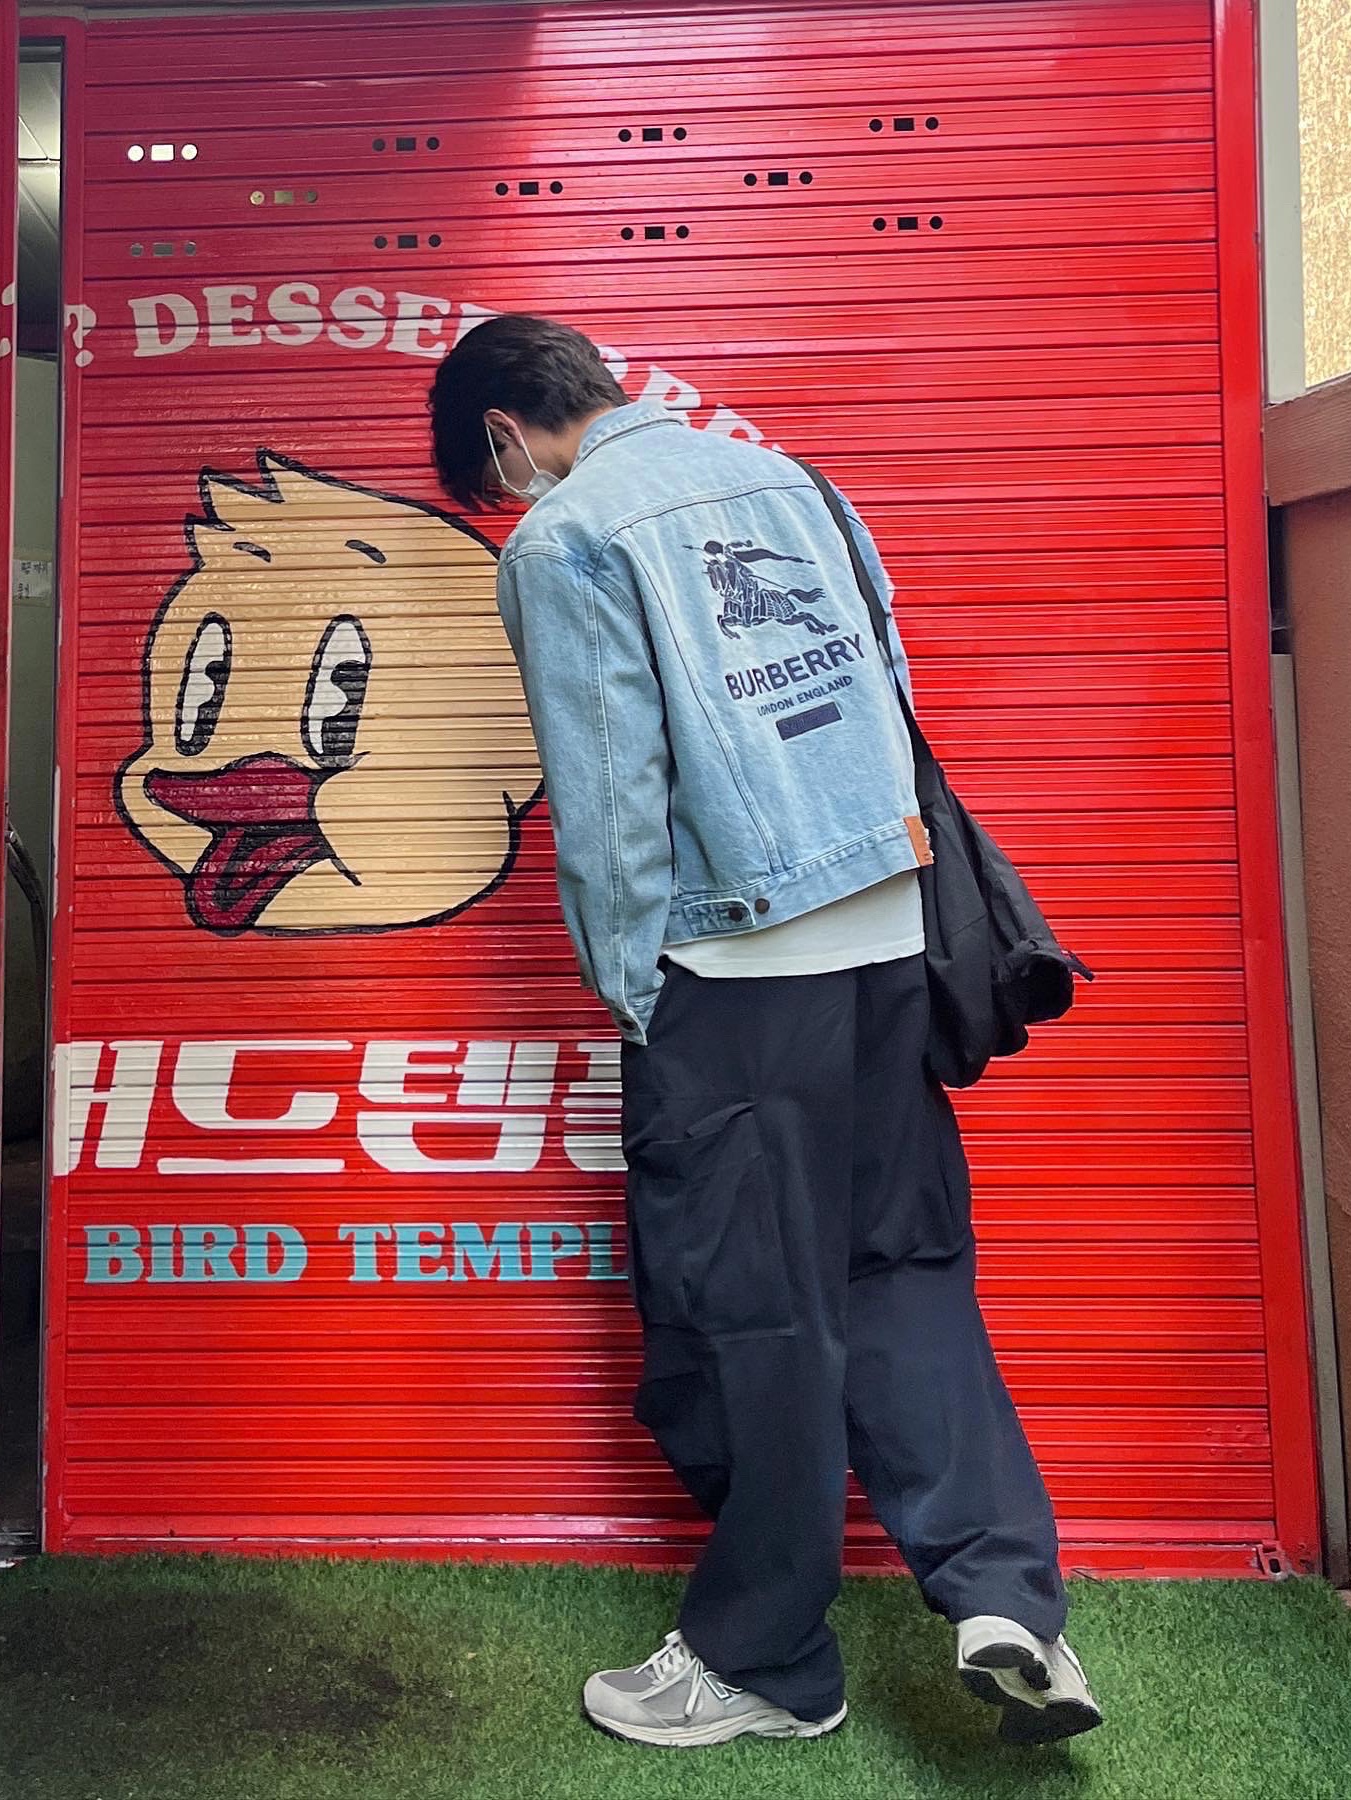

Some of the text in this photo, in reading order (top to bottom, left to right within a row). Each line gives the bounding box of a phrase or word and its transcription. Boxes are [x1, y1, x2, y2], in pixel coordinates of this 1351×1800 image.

[725, 633, 865, 700] BURBERRY
[757, 675, 853, 717] LONDON ENGLAND
[84, 1223, 308, 1284] BIRD
